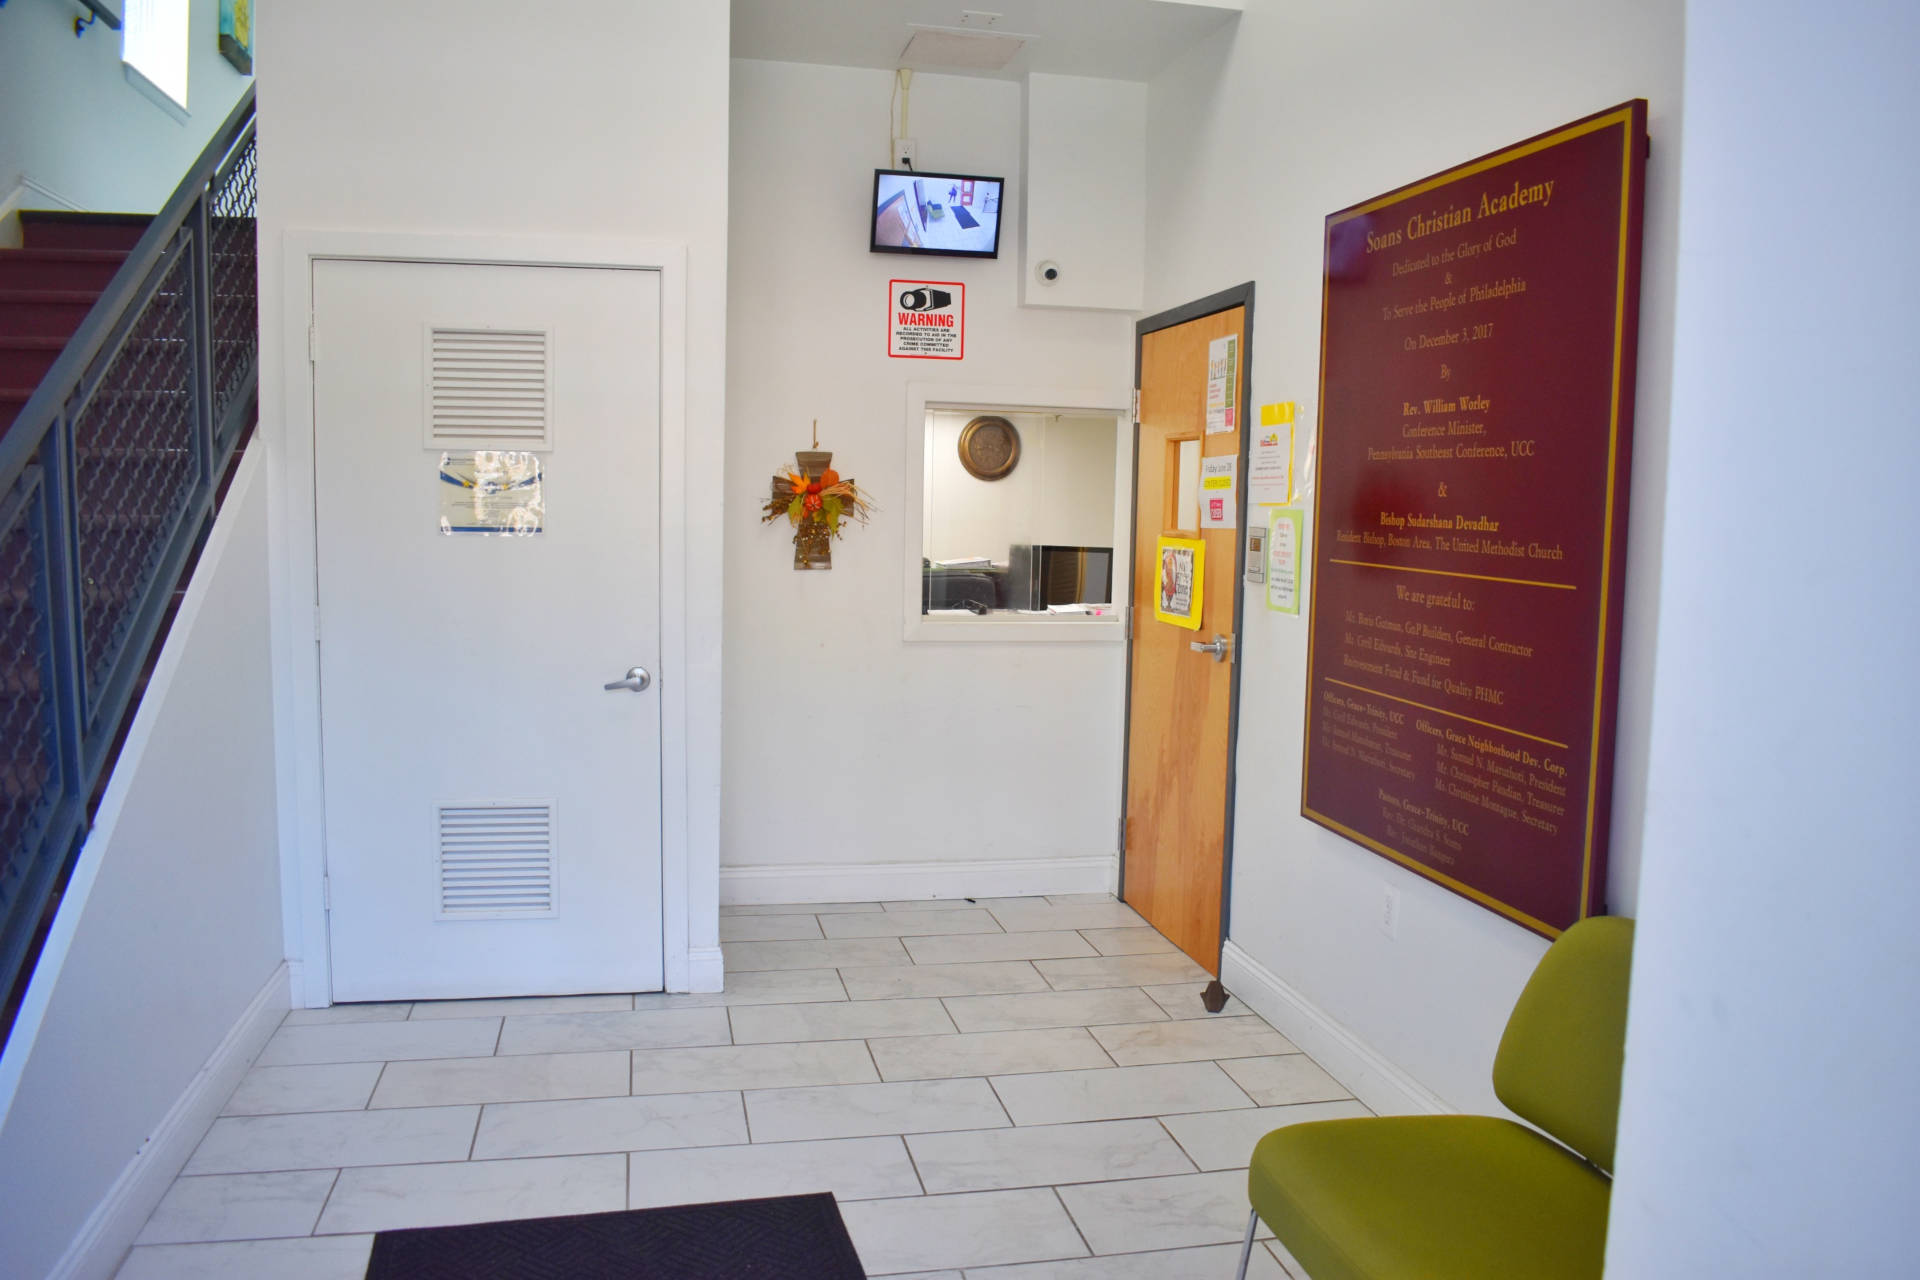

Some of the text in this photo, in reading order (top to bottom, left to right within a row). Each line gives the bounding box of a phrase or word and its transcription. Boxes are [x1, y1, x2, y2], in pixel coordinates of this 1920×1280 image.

[1366, 180, 1554, 254] Soans Christian Academy
[1392, 227, 1518, 277] Dedicated to the Glory of God
[1444, 272, 1453, 285] &
[1383, 277, 1526, 321] To Serve the People of Philadelphia
[898, 312, 954, 328] WARNING
[1404, 323, 1495, 351] On December 3, 2017
[1440, 364, 1450, 381] By
[1403, 394, 1490, 416] Rev. William Worley
[1403, 420, 1487, 438] Conference Minister,
[1368, 440, 1536, 462] Pennsylvania Southeast Conference, UCC
[1438, 481, 1448, 497] &
[1380, 511, 1499, 532] Bishop Sudarshana Devadhar
[1363, 531, 1386, 548] Bishop,
[1388, 533, 1411, 549] Boston
[1435, 536, 1450, 551] The
[1452, 537, 1479, 554] United
[1481, 539, 1525, 558] Methodist
[1528, 543, 1563, 561] Church
[1396, 584, 1475, 611] We are grateful to:
[1422, 625, 1454, 645] Builders,
[1455, 630, 1486, 649] General
[1488, 636, 1534, 657] Contractor
[1404, 645, 1417, 659] Site
[1419, 647, 1451, 667] Engineer
[1384, 663, 1401, 679] Fund
[1403, 669, 1410, 682] &
[1411, 670, 1431, 688] Fund
[1431, 674, 1442, 690] for
[1444, 678, 1473, 698] Quality
[1475, 686, 1504, 705] PHMC
[1389, 710, 1405, 727] UCC
[1416, 719, 1568, 780] Officers, Grace Neighborhood Dev. Corp.
[1450, 748, 1475, 766] Samuel
[1528, 773, 1566, 797] President
[1527, 791, 1565, 817] Treasurer
[1452, 818, 1469, 836] UCC
[1521, 810, 1558, 836] Secretary
